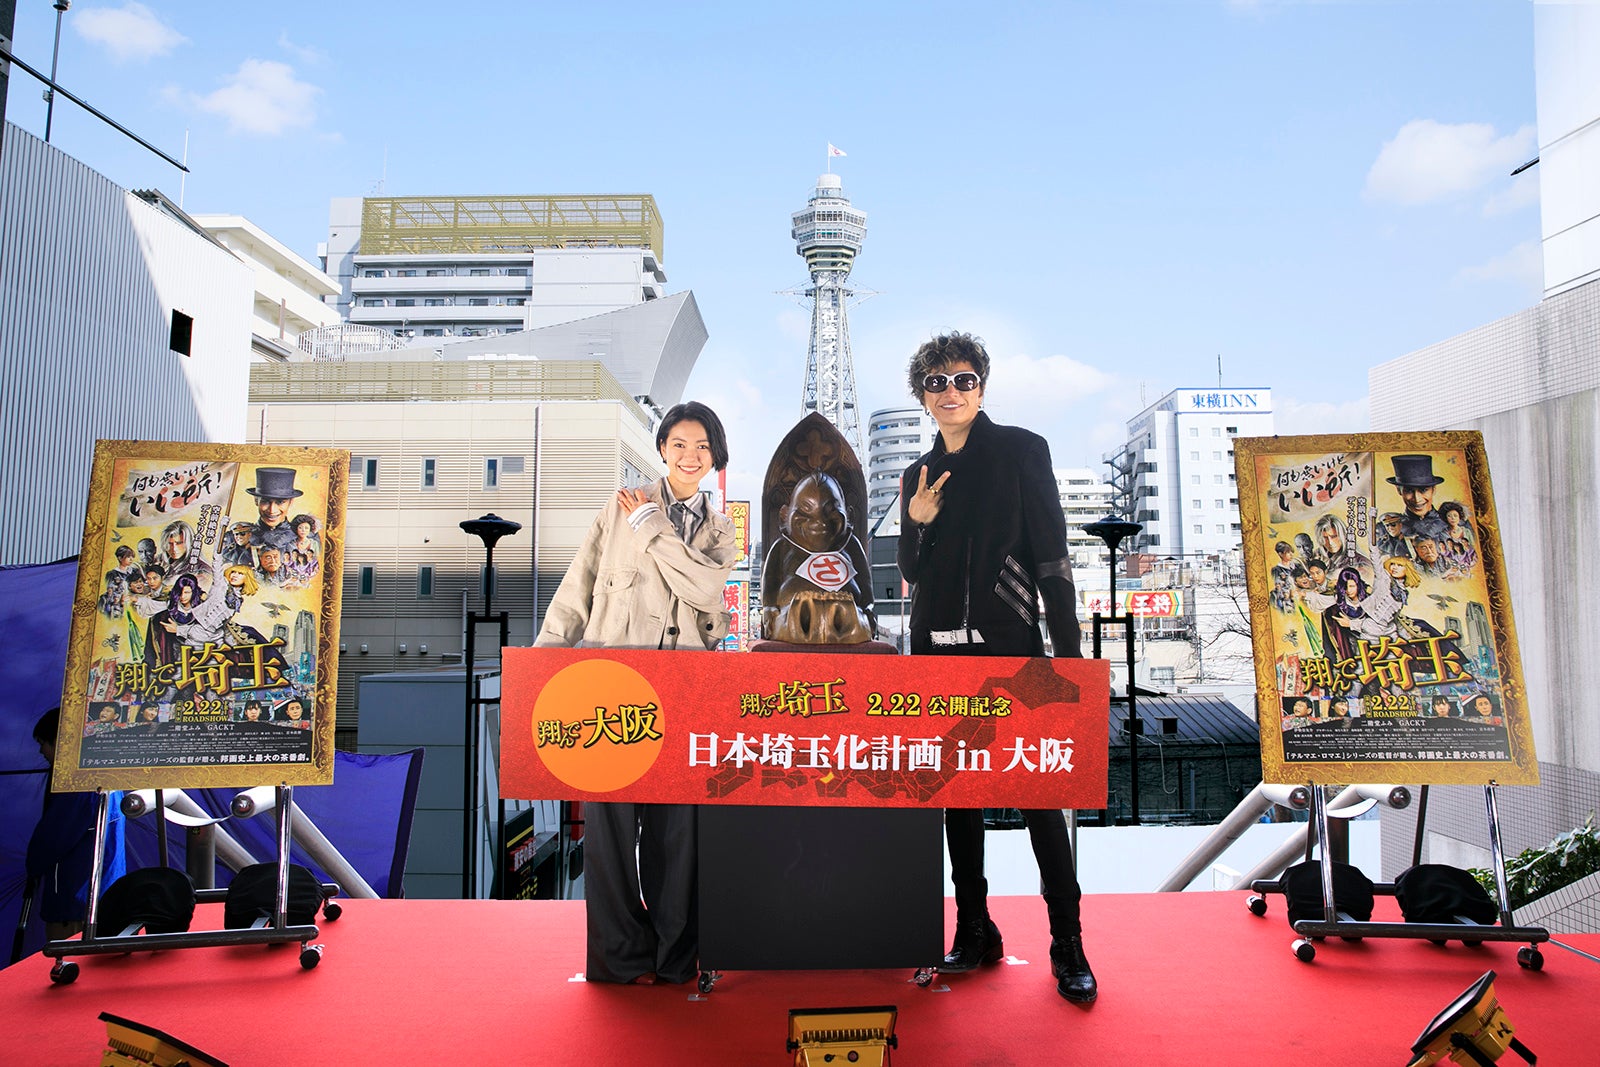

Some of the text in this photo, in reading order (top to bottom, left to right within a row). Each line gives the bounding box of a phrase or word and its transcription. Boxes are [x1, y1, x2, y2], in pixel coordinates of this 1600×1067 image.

[1191, 393, 1257, 409] 東横INN
[132, 463, 209, 492] 何も無いけど
[1276, 455, 1345, 488] 何も無いけど
[1278, 463, 1360, 513] いい所！
[129, 472, 222, 517] いい所！
[813, 558, 840, 582] さ
[115, 637, 292, 698] 翔んで埼玉
[1300, 629, 1473, 693] 翔んで埼玉
[183, 700, 222, 715] 2.22
[740, 677, 1012, 718] 翔んで埼玉 2.22 公開記念
[1371, 695, 1410, 710] 2.22
[537, 703, 663, 749] 翔んで大阪
[689, 731, 1075, 773] 日本埼玉化計画 in 大阪
